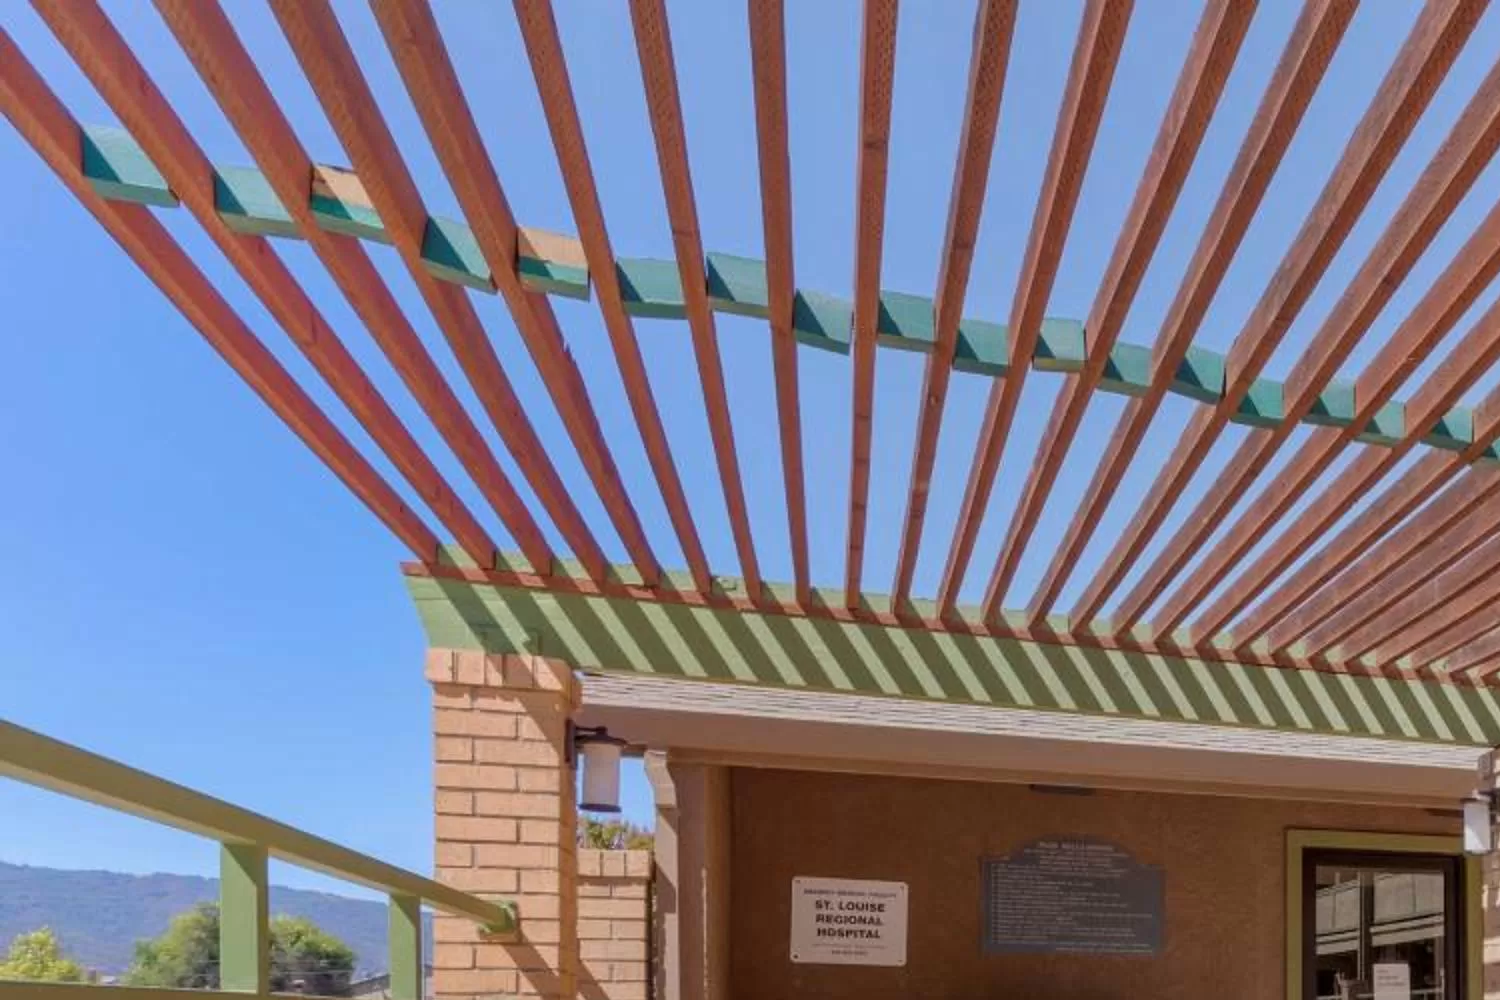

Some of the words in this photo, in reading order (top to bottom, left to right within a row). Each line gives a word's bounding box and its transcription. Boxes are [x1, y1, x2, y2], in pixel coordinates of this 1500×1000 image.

[815, 900, 834, 911] ST.
[839, 901, 886, 913] LOUISE
[815, 914, 884, 926] REGIONAL
[817, 927, 881, 939] HOSPITAL
